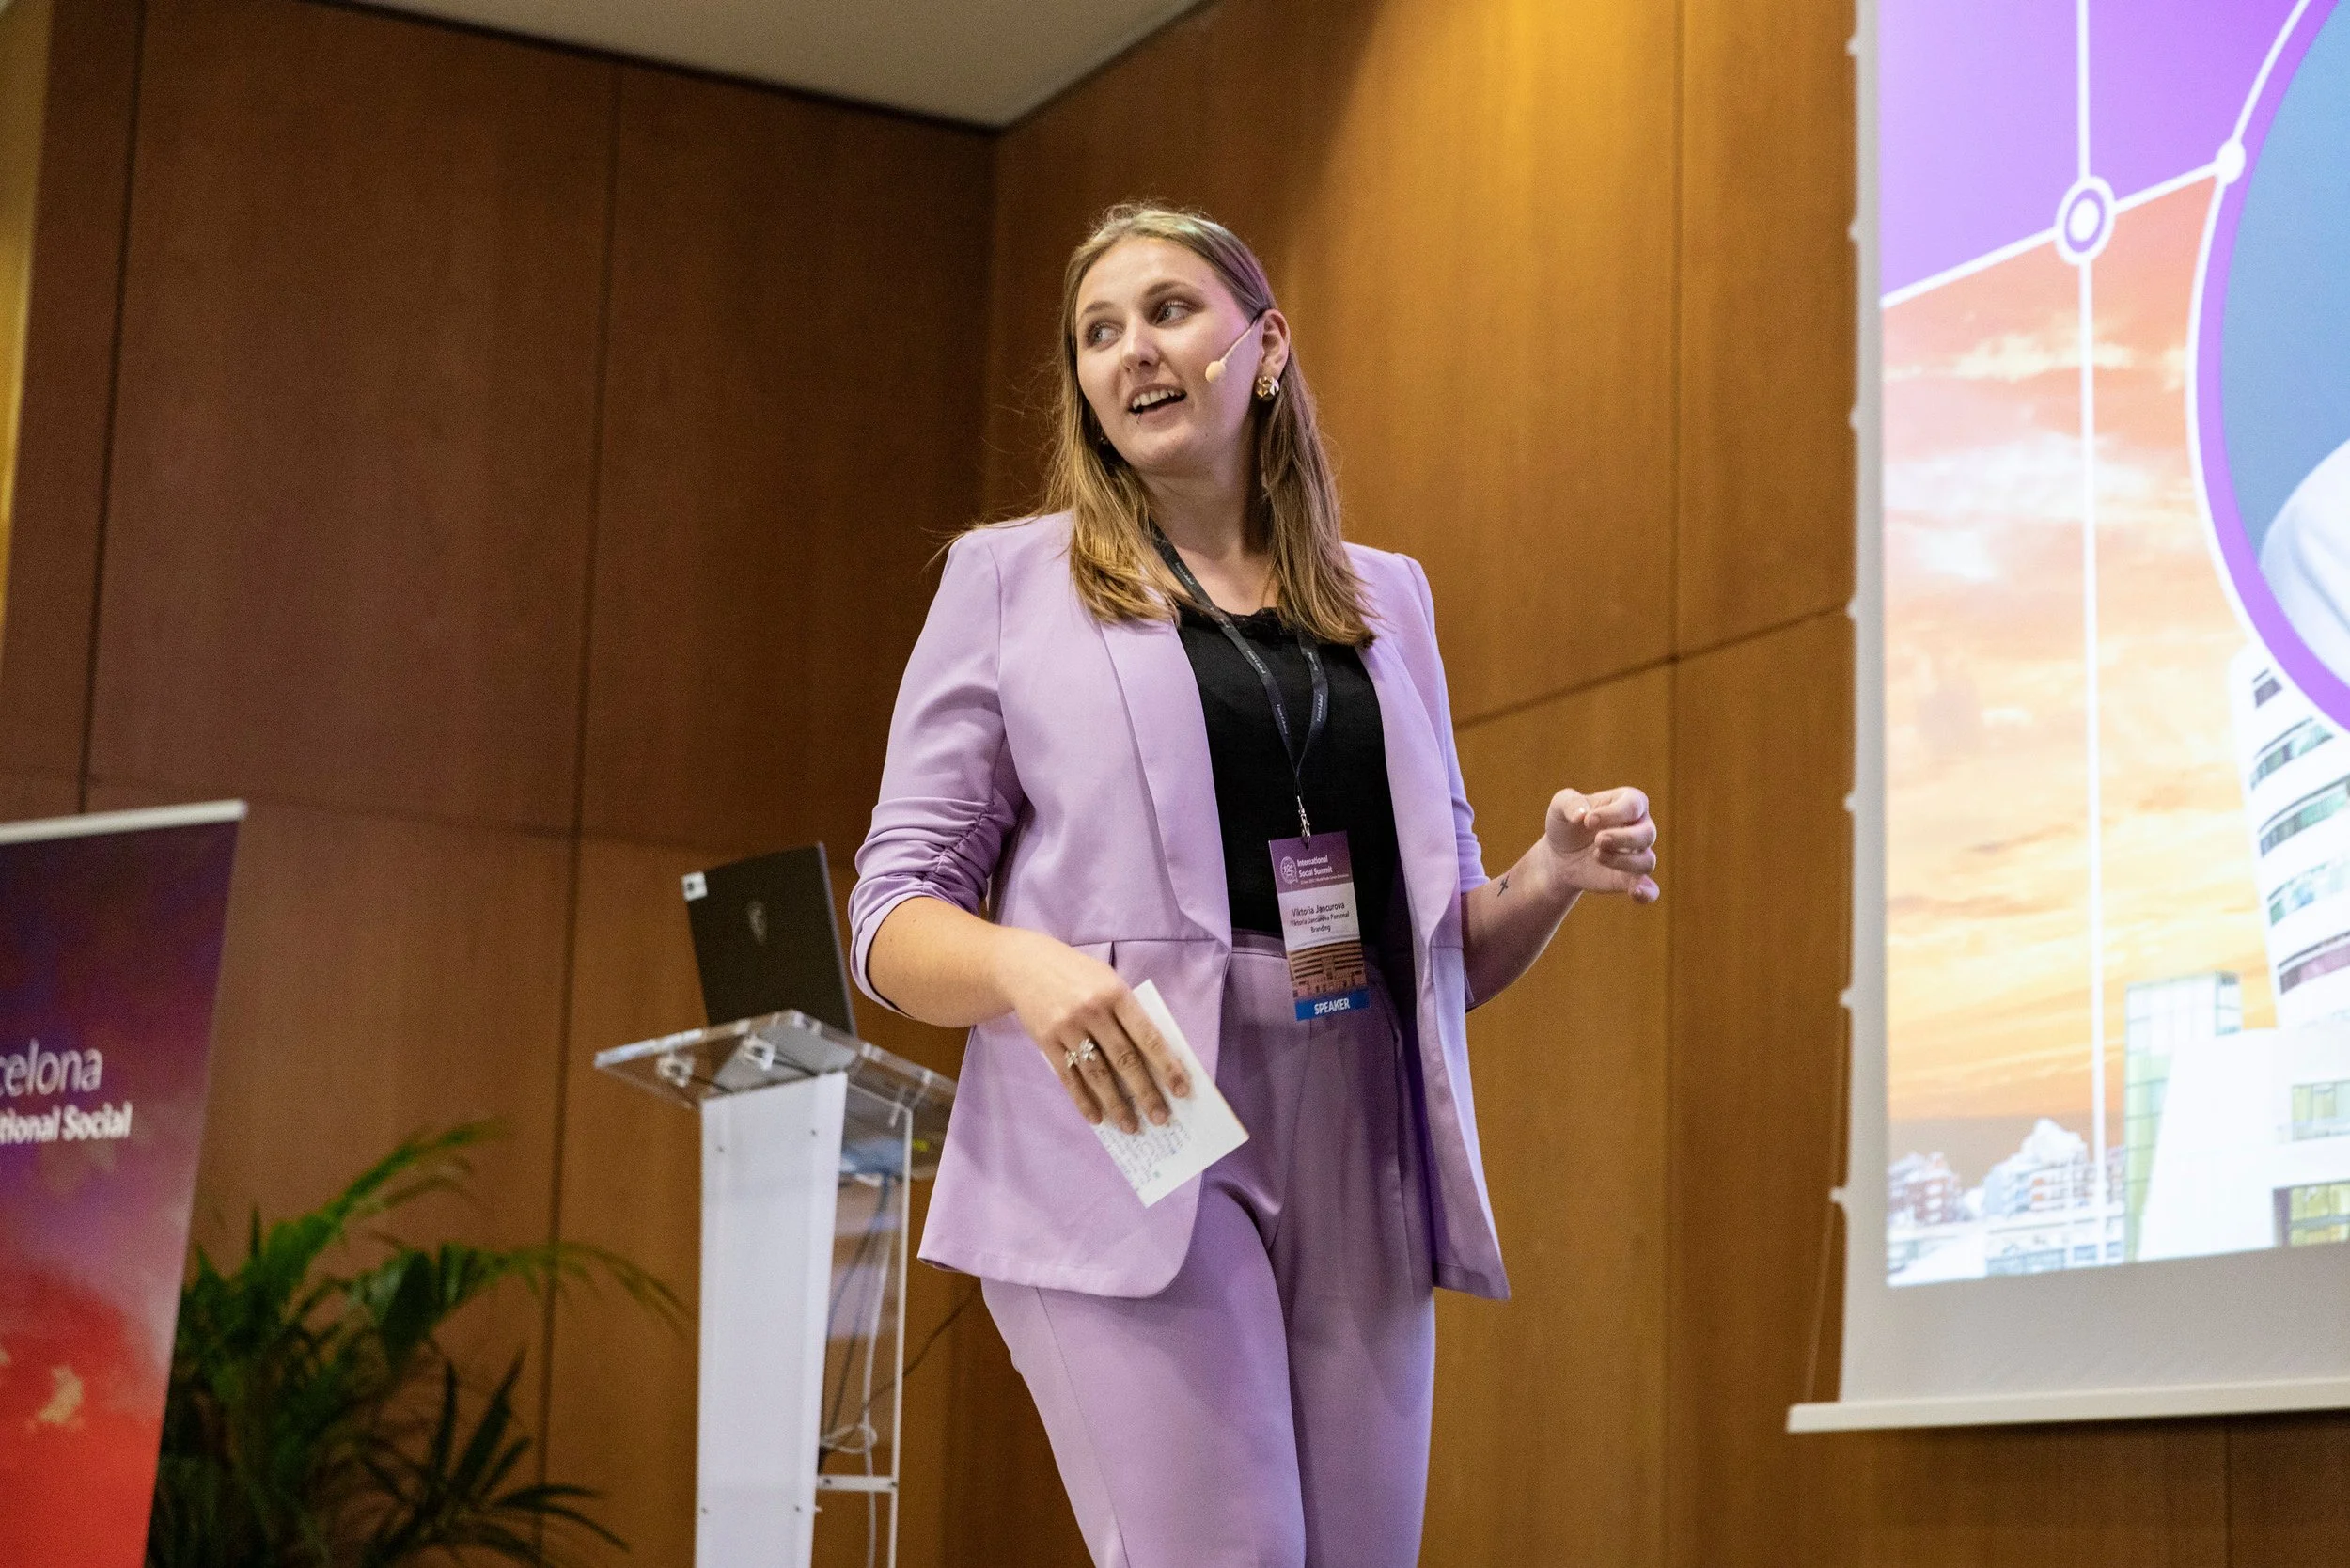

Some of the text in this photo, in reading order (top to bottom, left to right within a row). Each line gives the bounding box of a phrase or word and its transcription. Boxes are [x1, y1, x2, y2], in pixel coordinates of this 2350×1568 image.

[1297, 855, 1329, 867] International
[1298, 865, 1333, 878] Social Summit
[1291, 905, 1315, 917] Viktoria
[1330, 910, 1350, 920] Personal
[1310, 924, 1331, 933] Branding
[1313, 997, 1351, 1015] SPEAKER
[62, 1100, 133, 1141] Social
